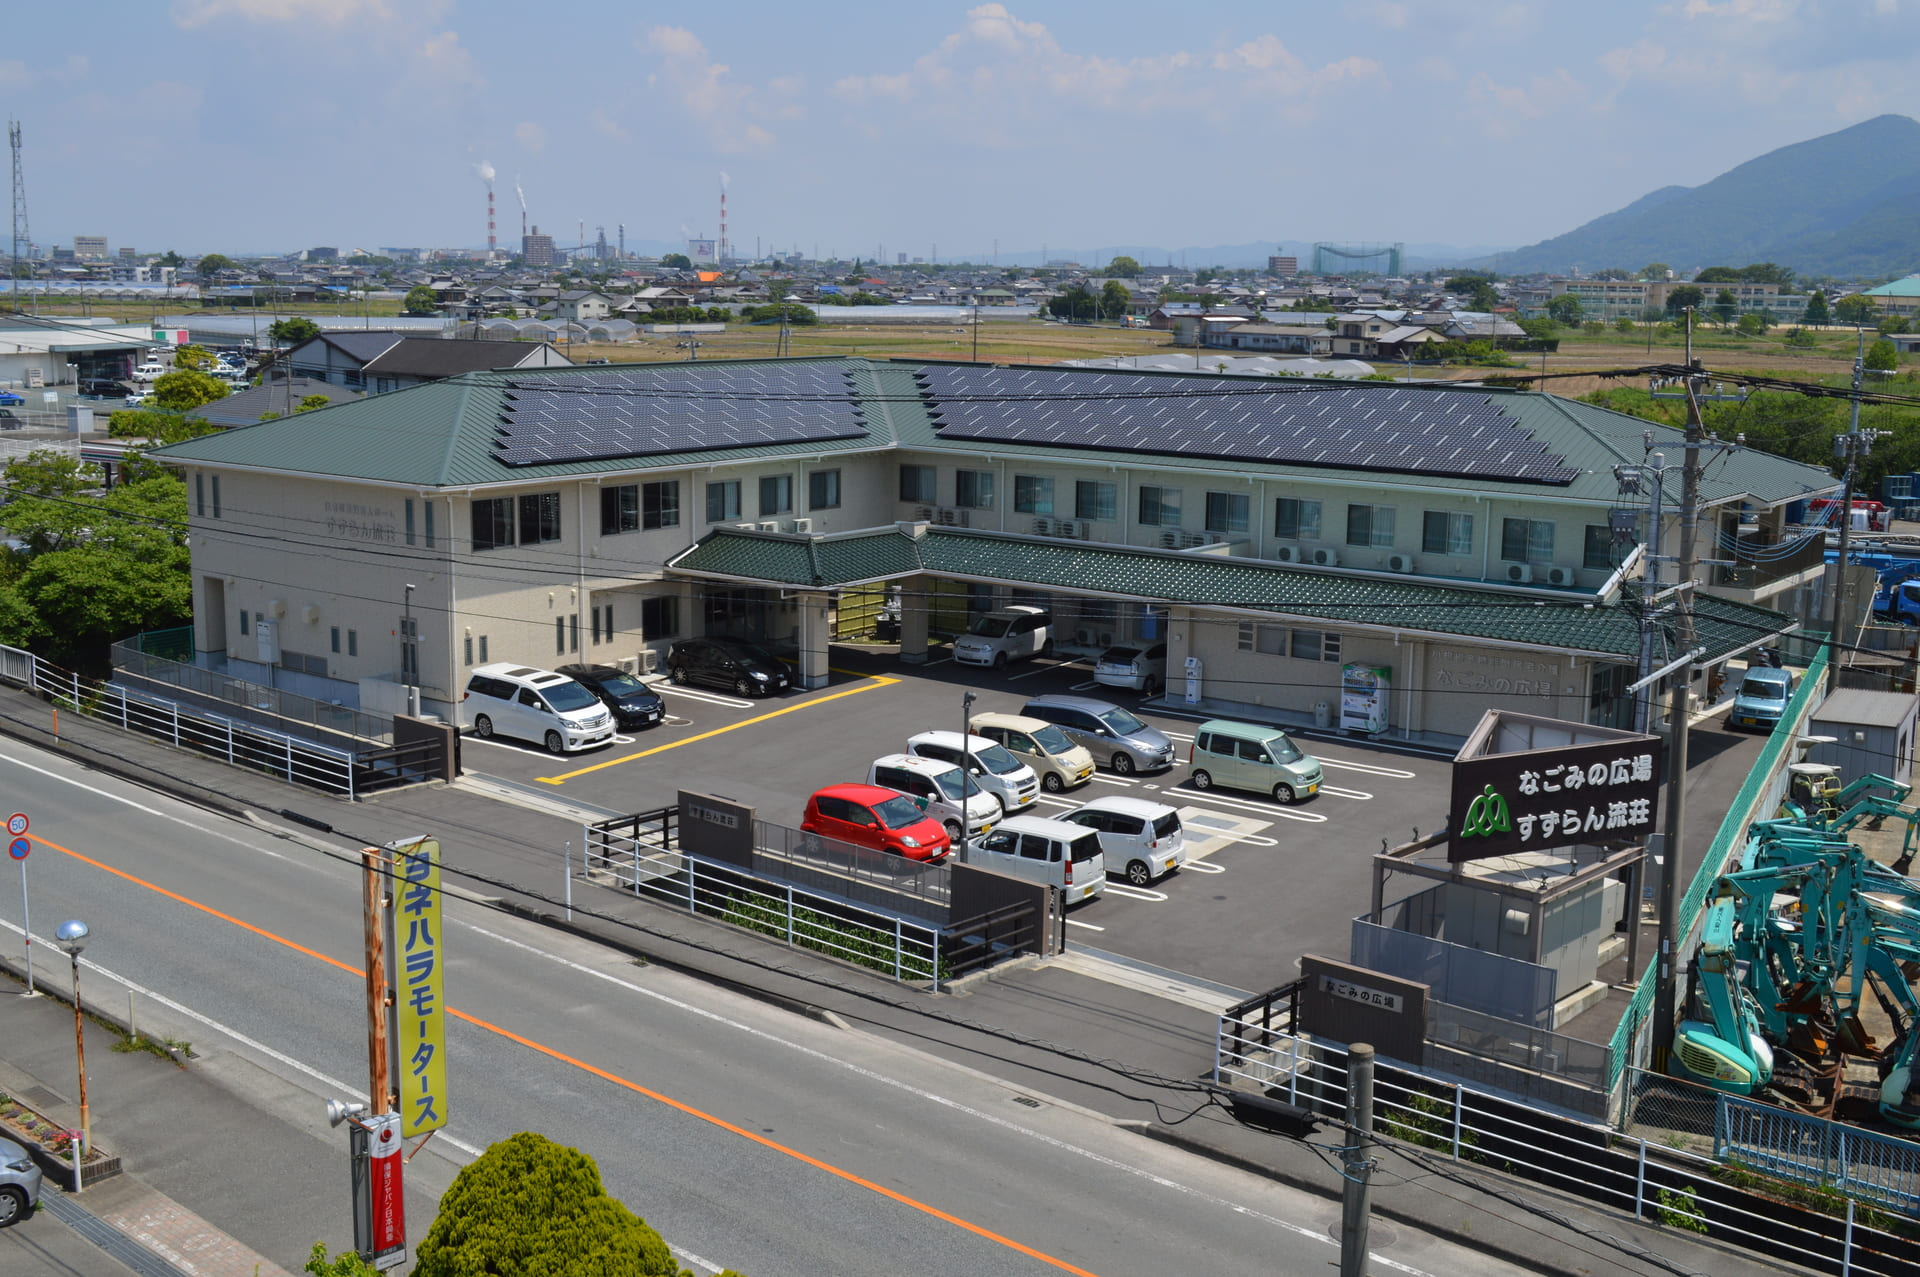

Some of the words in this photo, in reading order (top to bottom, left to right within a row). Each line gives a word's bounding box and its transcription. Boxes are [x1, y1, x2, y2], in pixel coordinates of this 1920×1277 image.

[1436, 668, 1552, 700] なごみの広場
[1518, 754, 1653, 795] なごみの広場
[11, 818, 25, 831] 50
[1516, 798, 1650, 842] すずらん流荘
[404, 851, 439, 1128] ヨネハラモータース
[1326, 981, 1395, 1009] なごみの広場
